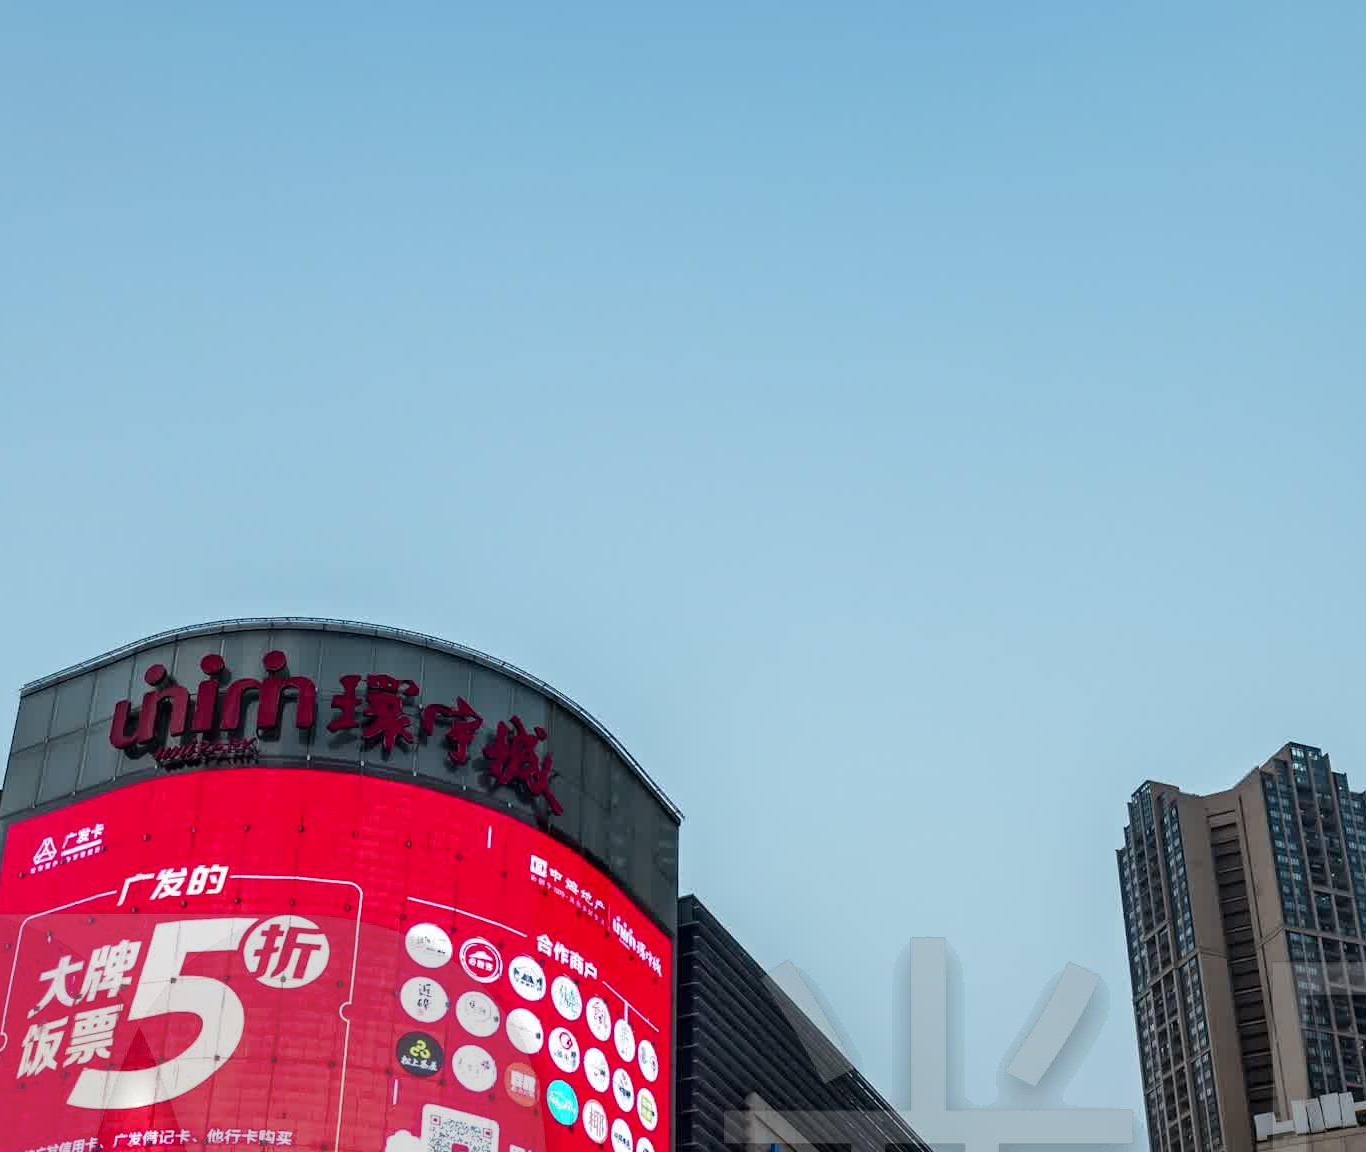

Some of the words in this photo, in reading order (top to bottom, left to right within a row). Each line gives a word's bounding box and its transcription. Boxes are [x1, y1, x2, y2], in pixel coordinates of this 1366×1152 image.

[62, 823, 104, 849] 广发卡
[117, 864, 229, 906] 广发的
[27, 938, 142, 1020] 大牌
[536, 933, 597, 980] 合作商户
[17, 1003, 124, 1080] 饭票
[66, 917, 260, 1110] 5
[256, 923, 327, 984] 折
